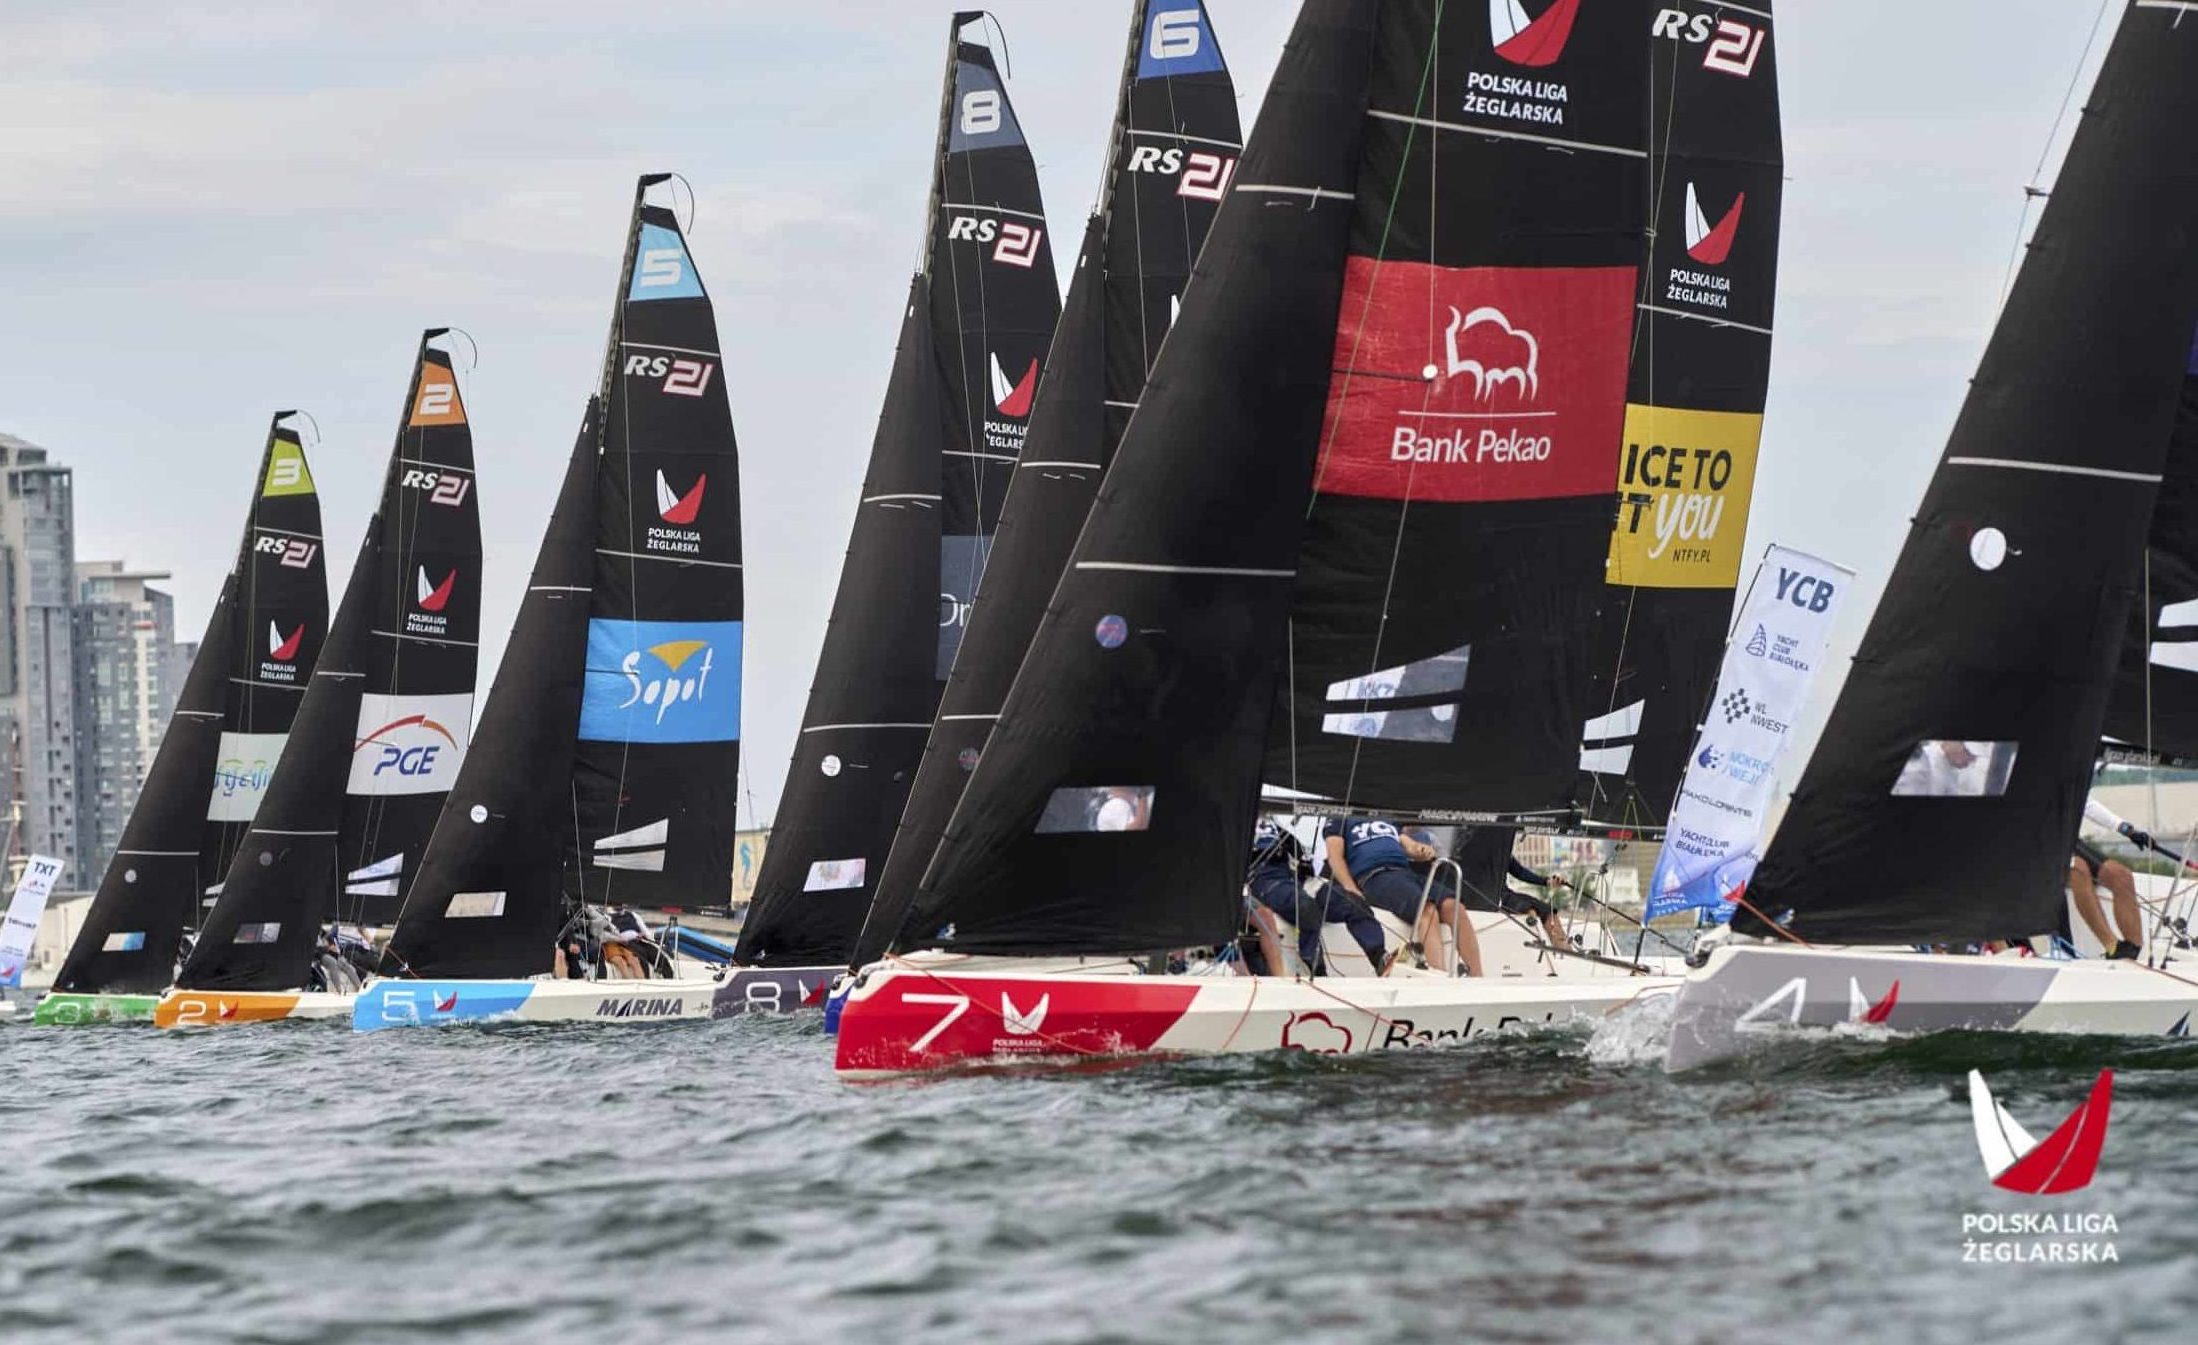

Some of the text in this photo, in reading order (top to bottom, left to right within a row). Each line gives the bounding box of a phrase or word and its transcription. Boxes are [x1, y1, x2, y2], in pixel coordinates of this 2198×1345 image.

[1149, 9, 1200, 59] 6
[1652, 8, 1764, 77] RS21
[1467, 72, 1568, 102] POLSKA LIGA
[961, 90, 1000, 134] 8
[1463, 91, 1563, 125] ŻEGLARSKA
[1128, 146, 1235, 202] RS21
[948, 216, 1042, 268] RS21
[640, 249, 682, 287] 5
[1670, 268, 1730, 291] POLSKA LIGA
[1666, 283, 1727, 309] ŻEGLARSKA
[624, 355, 715, 397] RS21
[420, 383, 453, 415] 2
[984, 421, 1017, 435] POLSKA
[1391, 426, 1551, 463] Bank Pekao
[272, 458, 301, 486] 3
[1624, 443, 1733, 491] ICE TO
[402, 469, 470, 506] RS21
[648, 527, 700, 542] POLSKA LIGA
[255, 536, 317, 568] RS21
[1672, 548, 1712, 563] NTFY.PL
[1776, 567, 1834, 613] YCB
[620, 647, 713, 725] Sopot
[374, 746, 440, 776] PGE
[34, 861, 56, 877] TXT
[177, 1000, 207, 1025] 2
[381, 990, 419, 1022] 5
[596, 998, 683, 1017] MARINA
[901, 992, 971, 1052] 7
